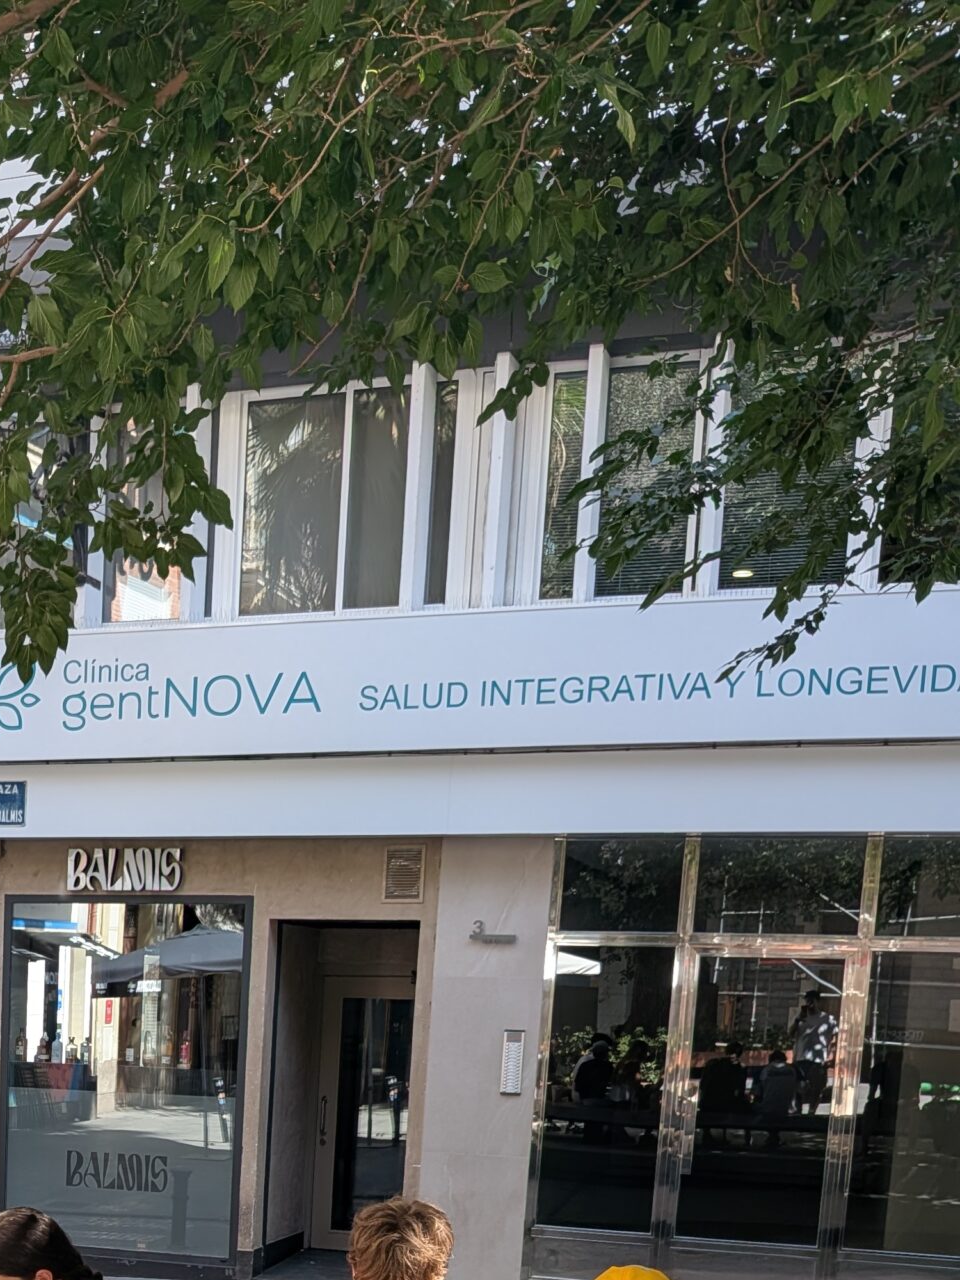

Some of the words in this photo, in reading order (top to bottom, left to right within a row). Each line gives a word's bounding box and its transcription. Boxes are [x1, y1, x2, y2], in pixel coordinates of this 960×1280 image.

[63, 657, 150, 684] Clínica
[358, 681, 469, 712] SALUD
[480, 671, 712, 708] INTEGRATIVA
[724, 670, 745, 699] Y
[756, 663, 960, 698] LONGEVID
[61, 671, 322, 732] gentNOVA
[66, 846, 181, 892] BALMIS
[472, 919, 485, 936] 3
[65, 1149, 169, 1193] BALMIS
